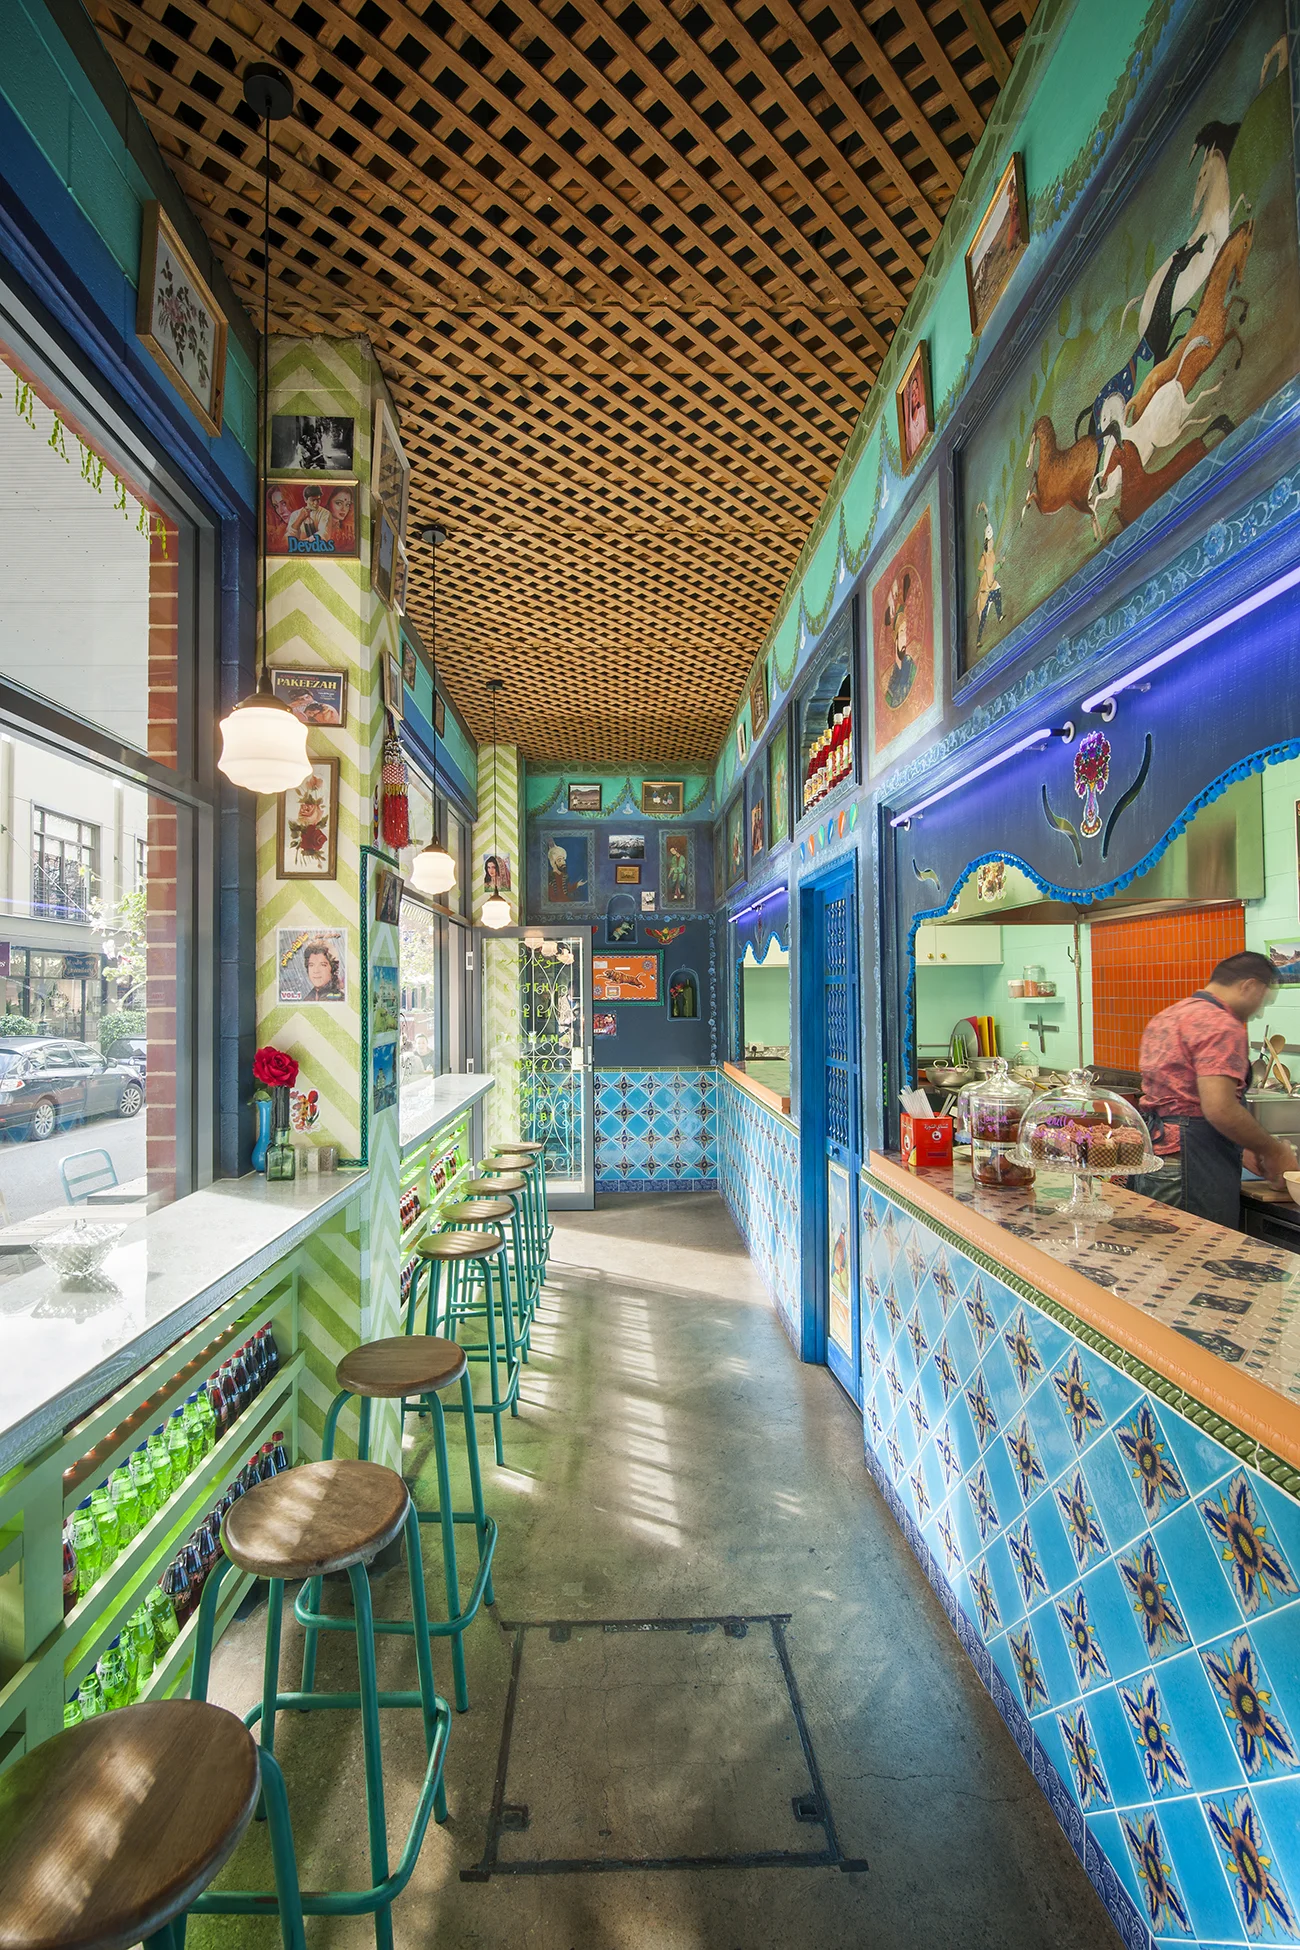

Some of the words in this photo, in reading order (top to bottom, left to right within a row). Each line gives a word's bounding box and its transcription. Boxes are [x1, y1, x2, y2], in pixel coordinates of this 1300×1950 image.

[288, 534, 335, 553] Devdas
[277, 678, 337, 690] PAKEEZAH
[510, 1008, 552, 1018] DELI
[541, 1060, 549, 1070] 7
